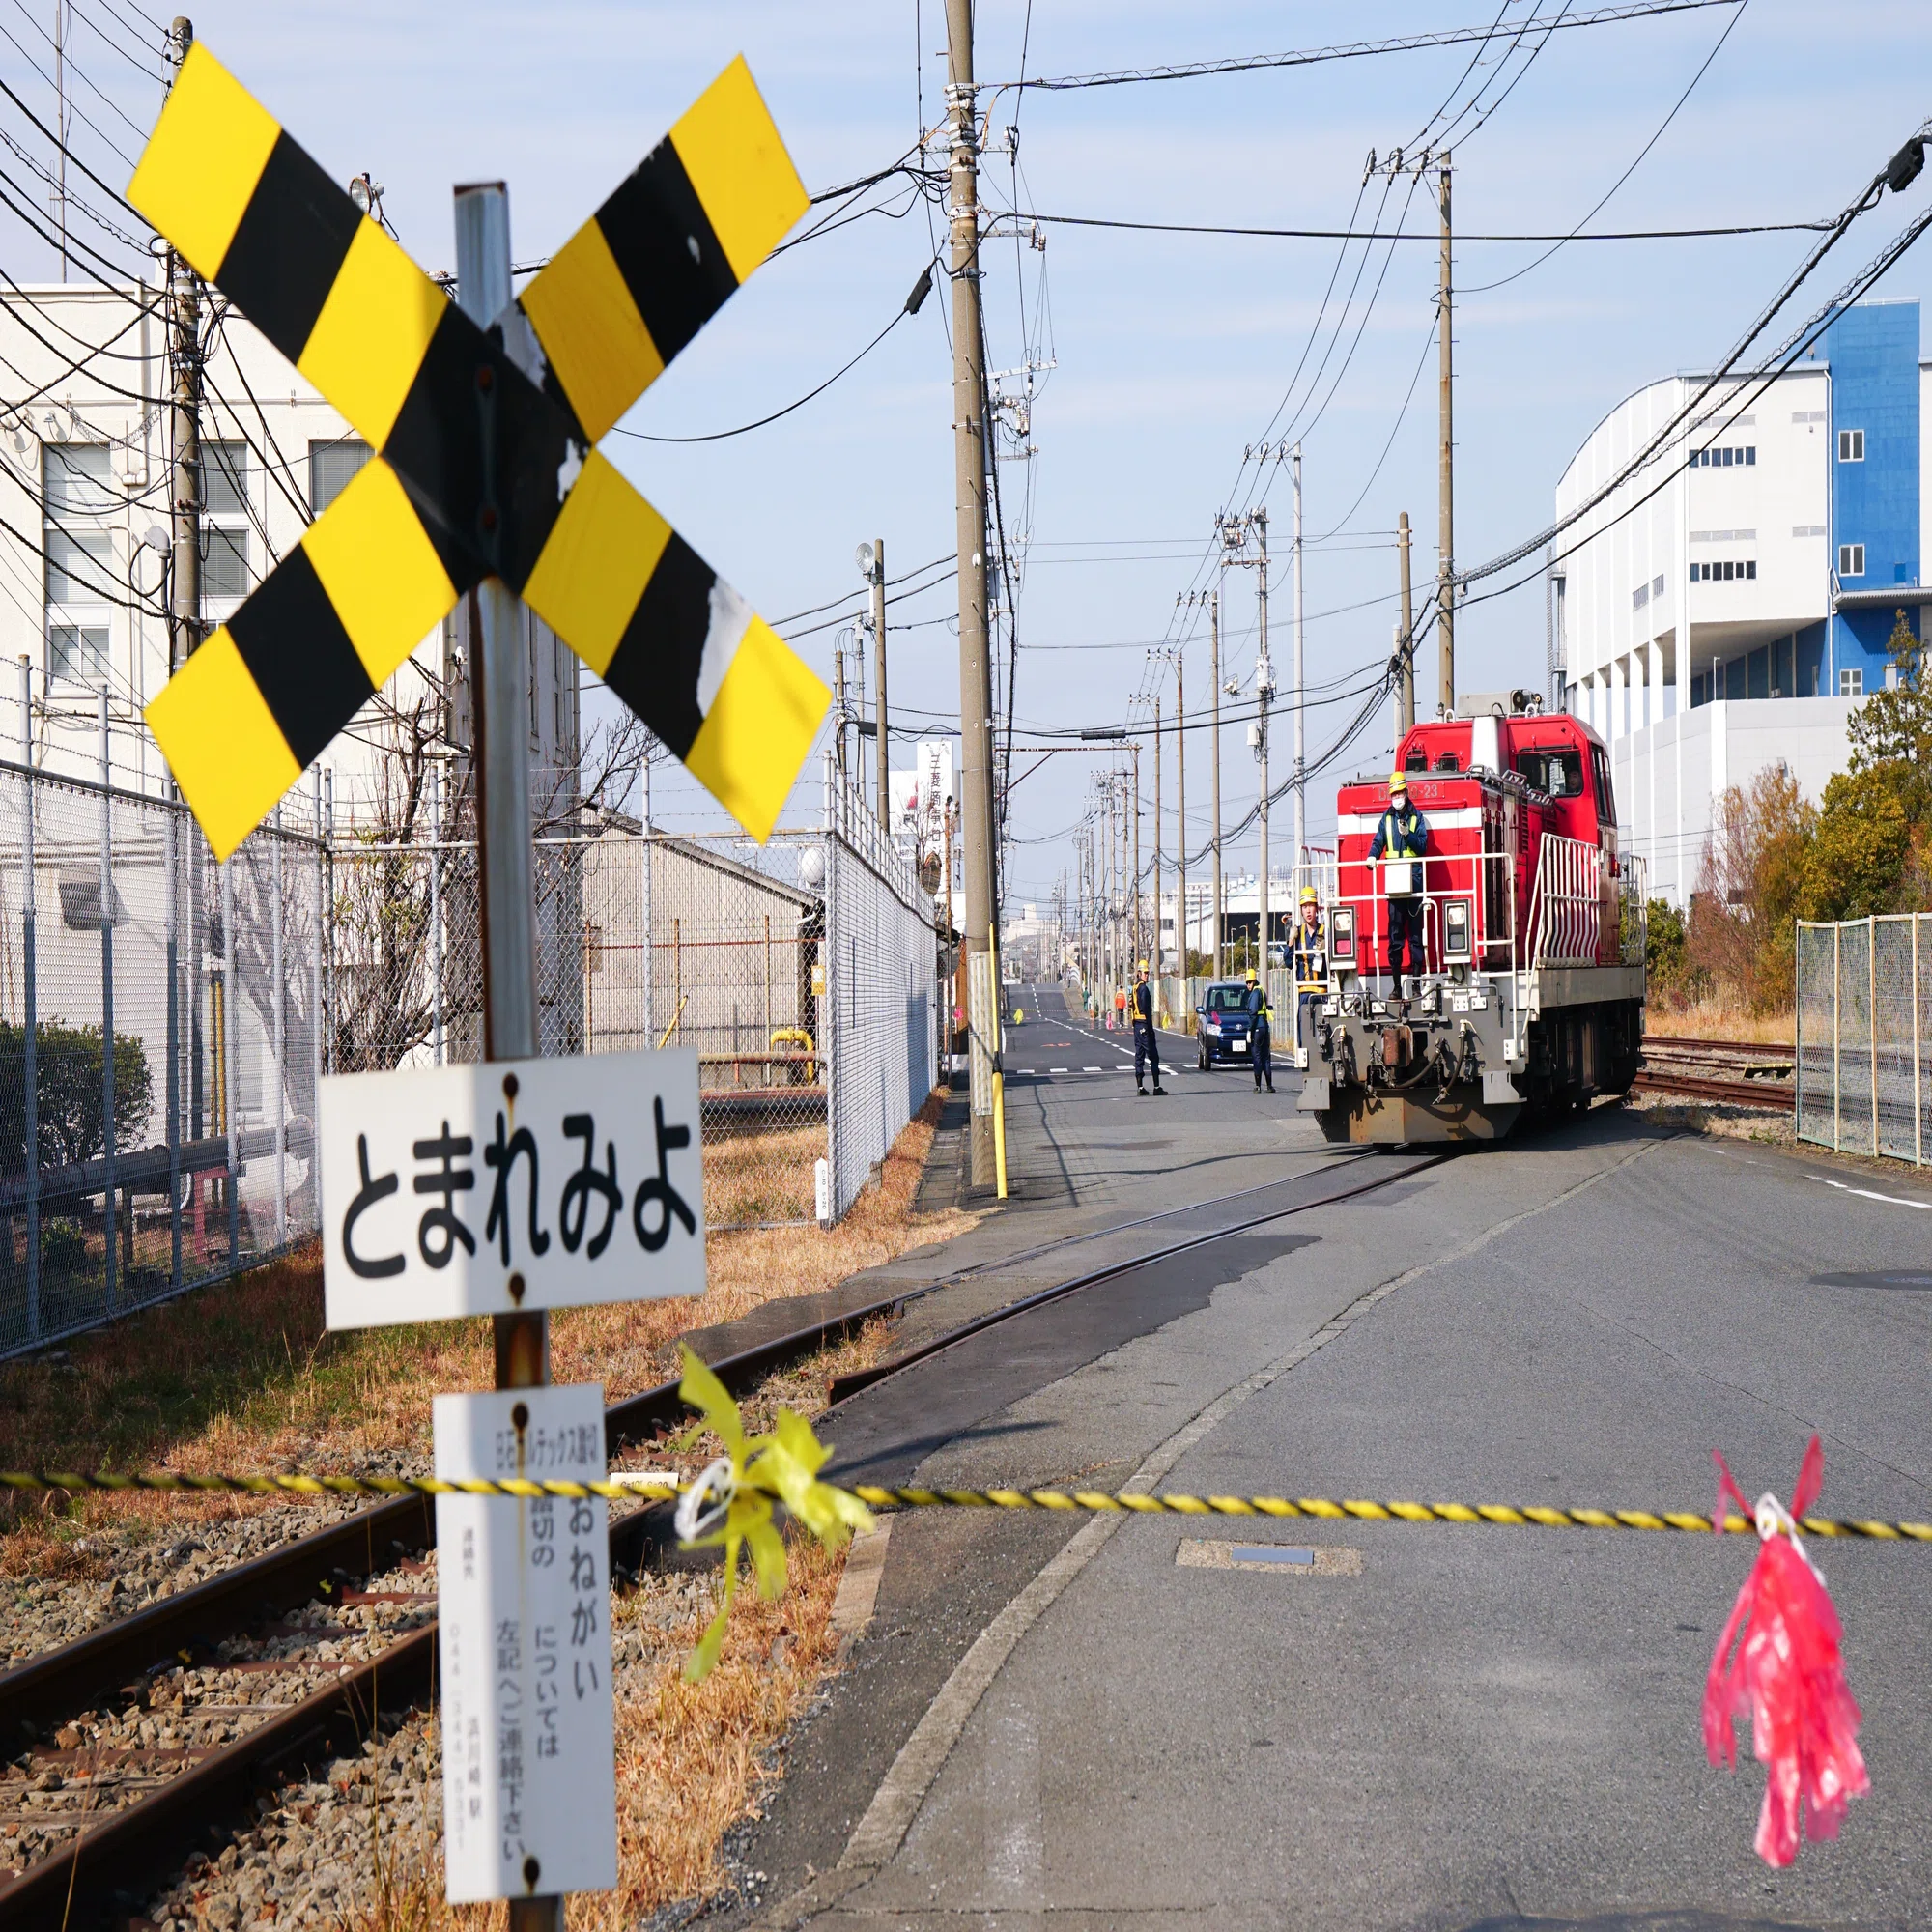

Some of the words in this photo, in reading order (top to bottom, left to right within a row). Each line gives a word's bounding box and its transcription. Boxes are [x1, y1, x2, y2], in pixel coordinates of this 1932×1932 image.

[1378, 783, 1438, 802] D0-23
[342, 1094, 696, 1279] とまれみよ
[569, 1480, 599, 1702] おねがい
[534, 1625, 560, 1760] については
